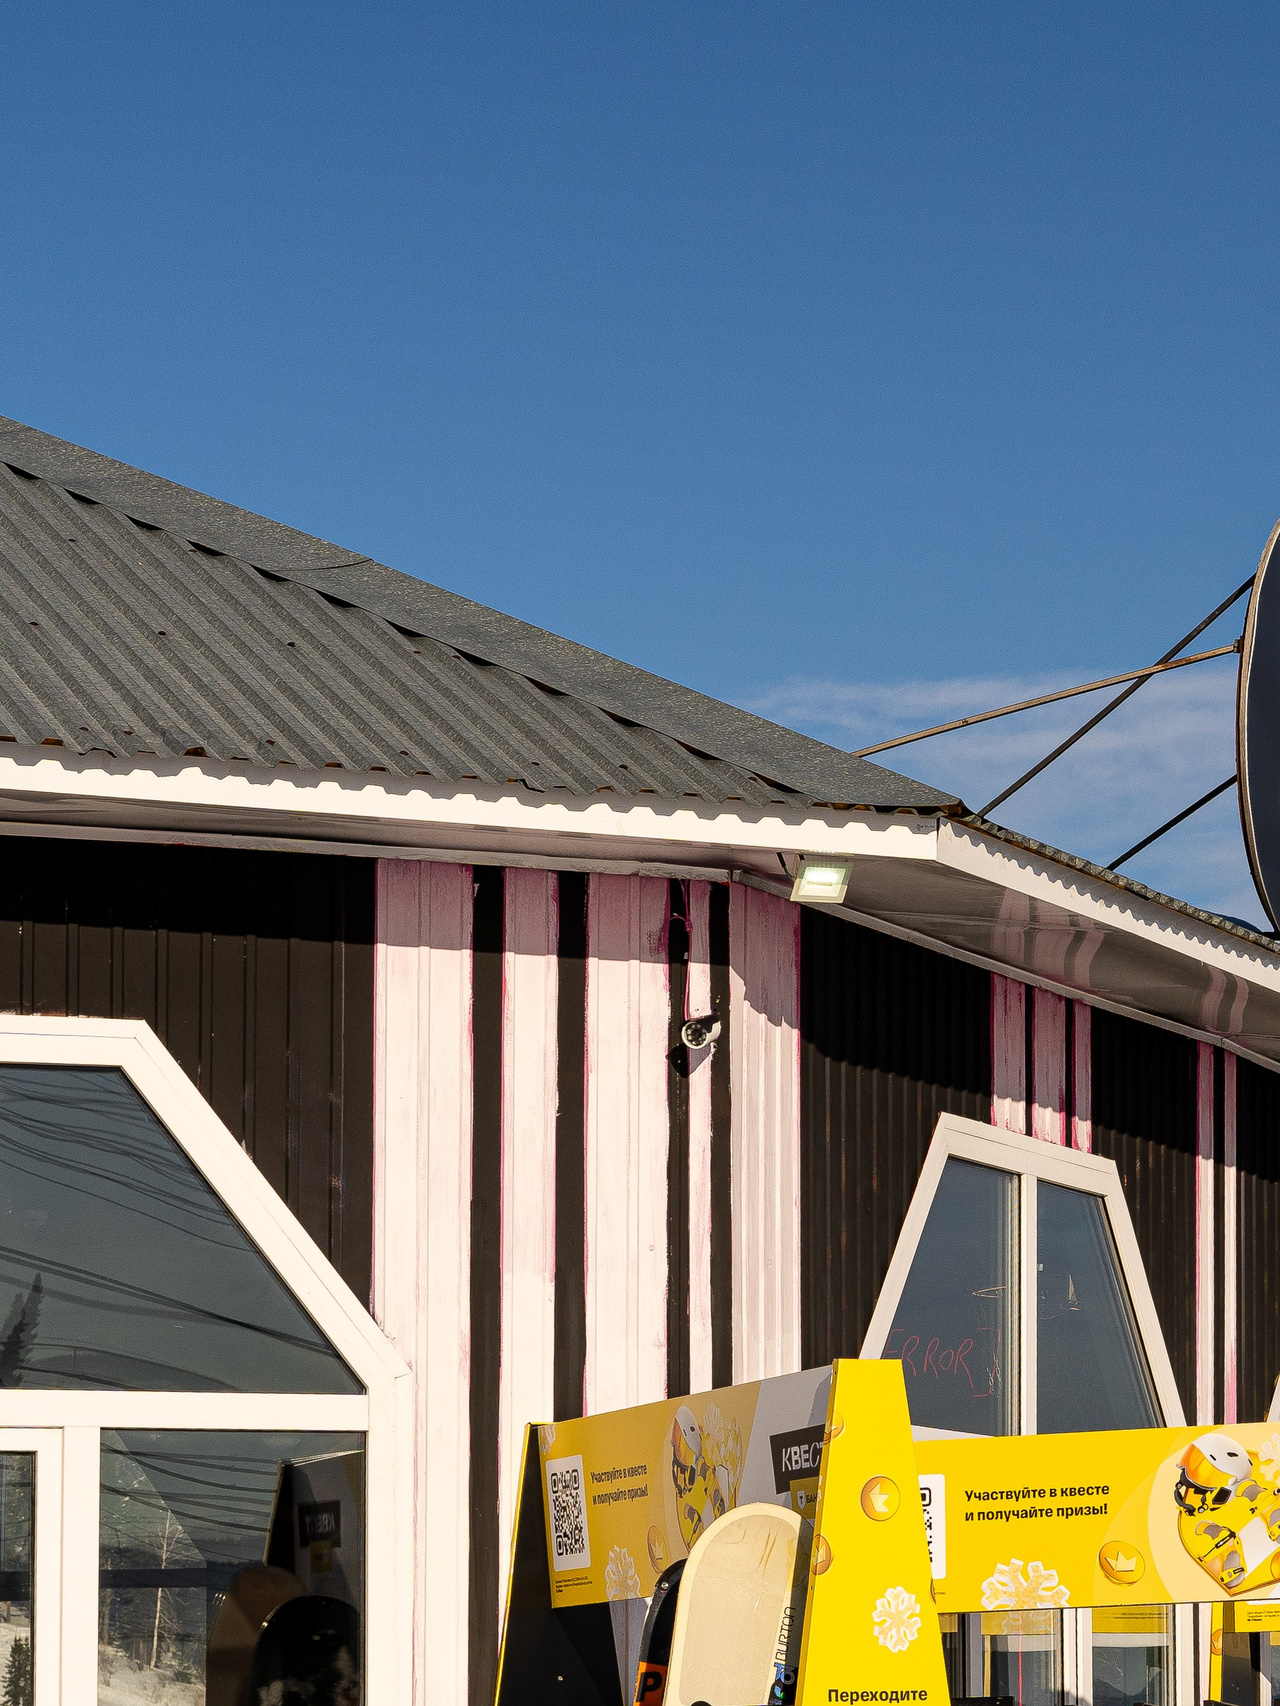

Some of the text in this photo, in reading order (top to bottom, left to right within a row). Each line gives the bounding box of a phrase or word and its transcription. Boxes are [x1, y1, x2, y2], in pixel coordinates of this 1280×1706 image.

[782, 1441, 824, 1472] КВЕС
[964, 1485, 1110, 1502] Участвуйте в квесте
[965, 1503, 1108, 1522] и получайте призы!
[775, 1606, 796, 1662] BURTON
[828, 1688, 928, 1706] Переходите
